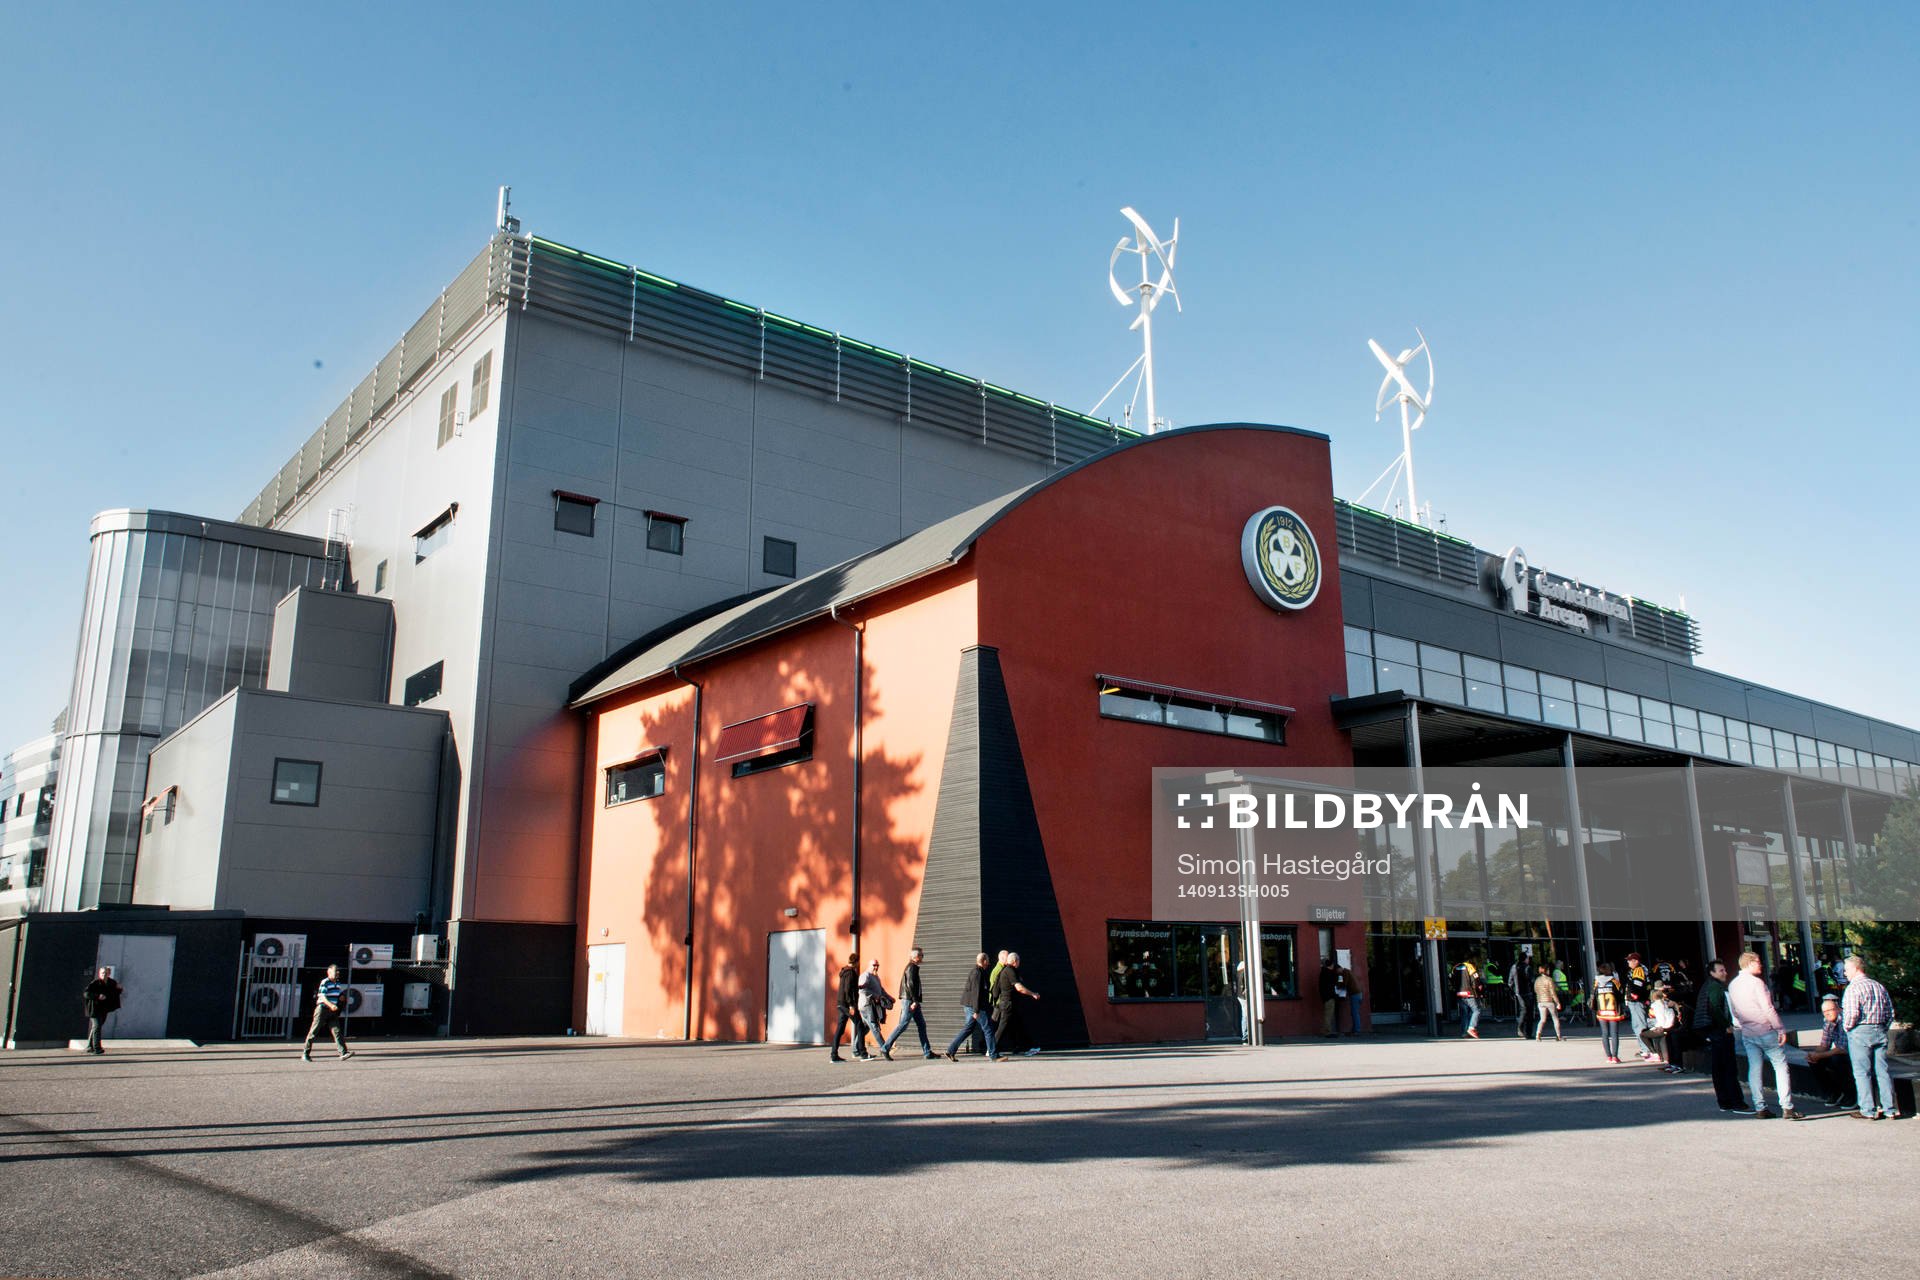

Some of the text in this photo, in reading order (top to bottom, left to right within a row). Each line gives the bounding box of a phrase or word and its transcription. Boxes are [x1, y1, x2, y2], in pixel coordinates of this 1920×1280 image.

[1277, 516, 1293, 529] 1912
[1316, 908, 1345, 921] Biljetter
[1259, 933, 1292, 941] sshopen
[1598, 993, 1615, 1011] 12
